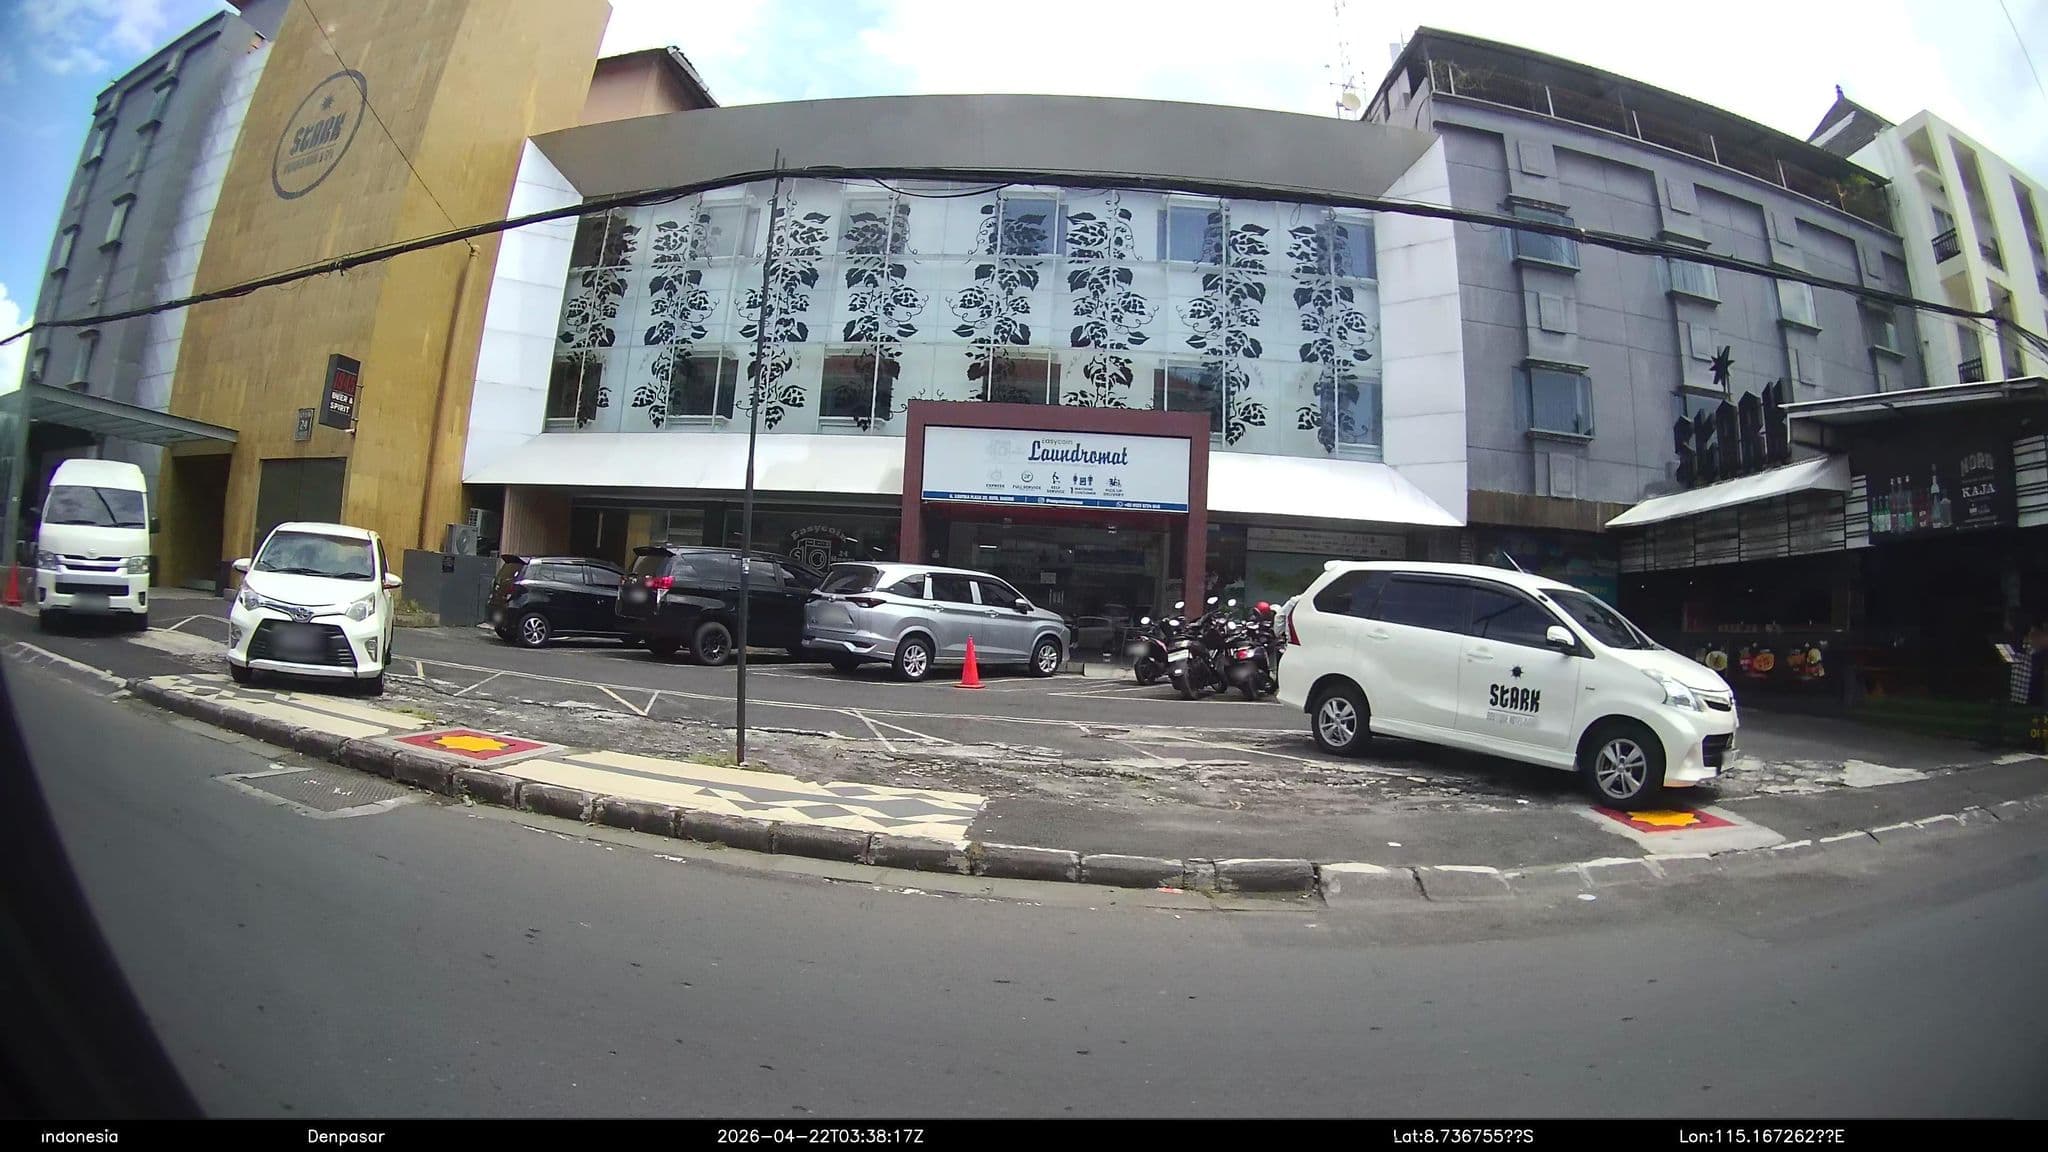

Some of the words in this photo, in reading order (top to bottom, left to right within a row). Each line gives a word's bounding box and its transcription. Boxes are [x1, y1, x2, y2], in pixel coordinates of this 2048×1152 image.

[329, 401, 350, 413] SPIRIT
[1028, 440, 1128, 466] Laundromat
[1962, 483, 1996, 498] KAJA
